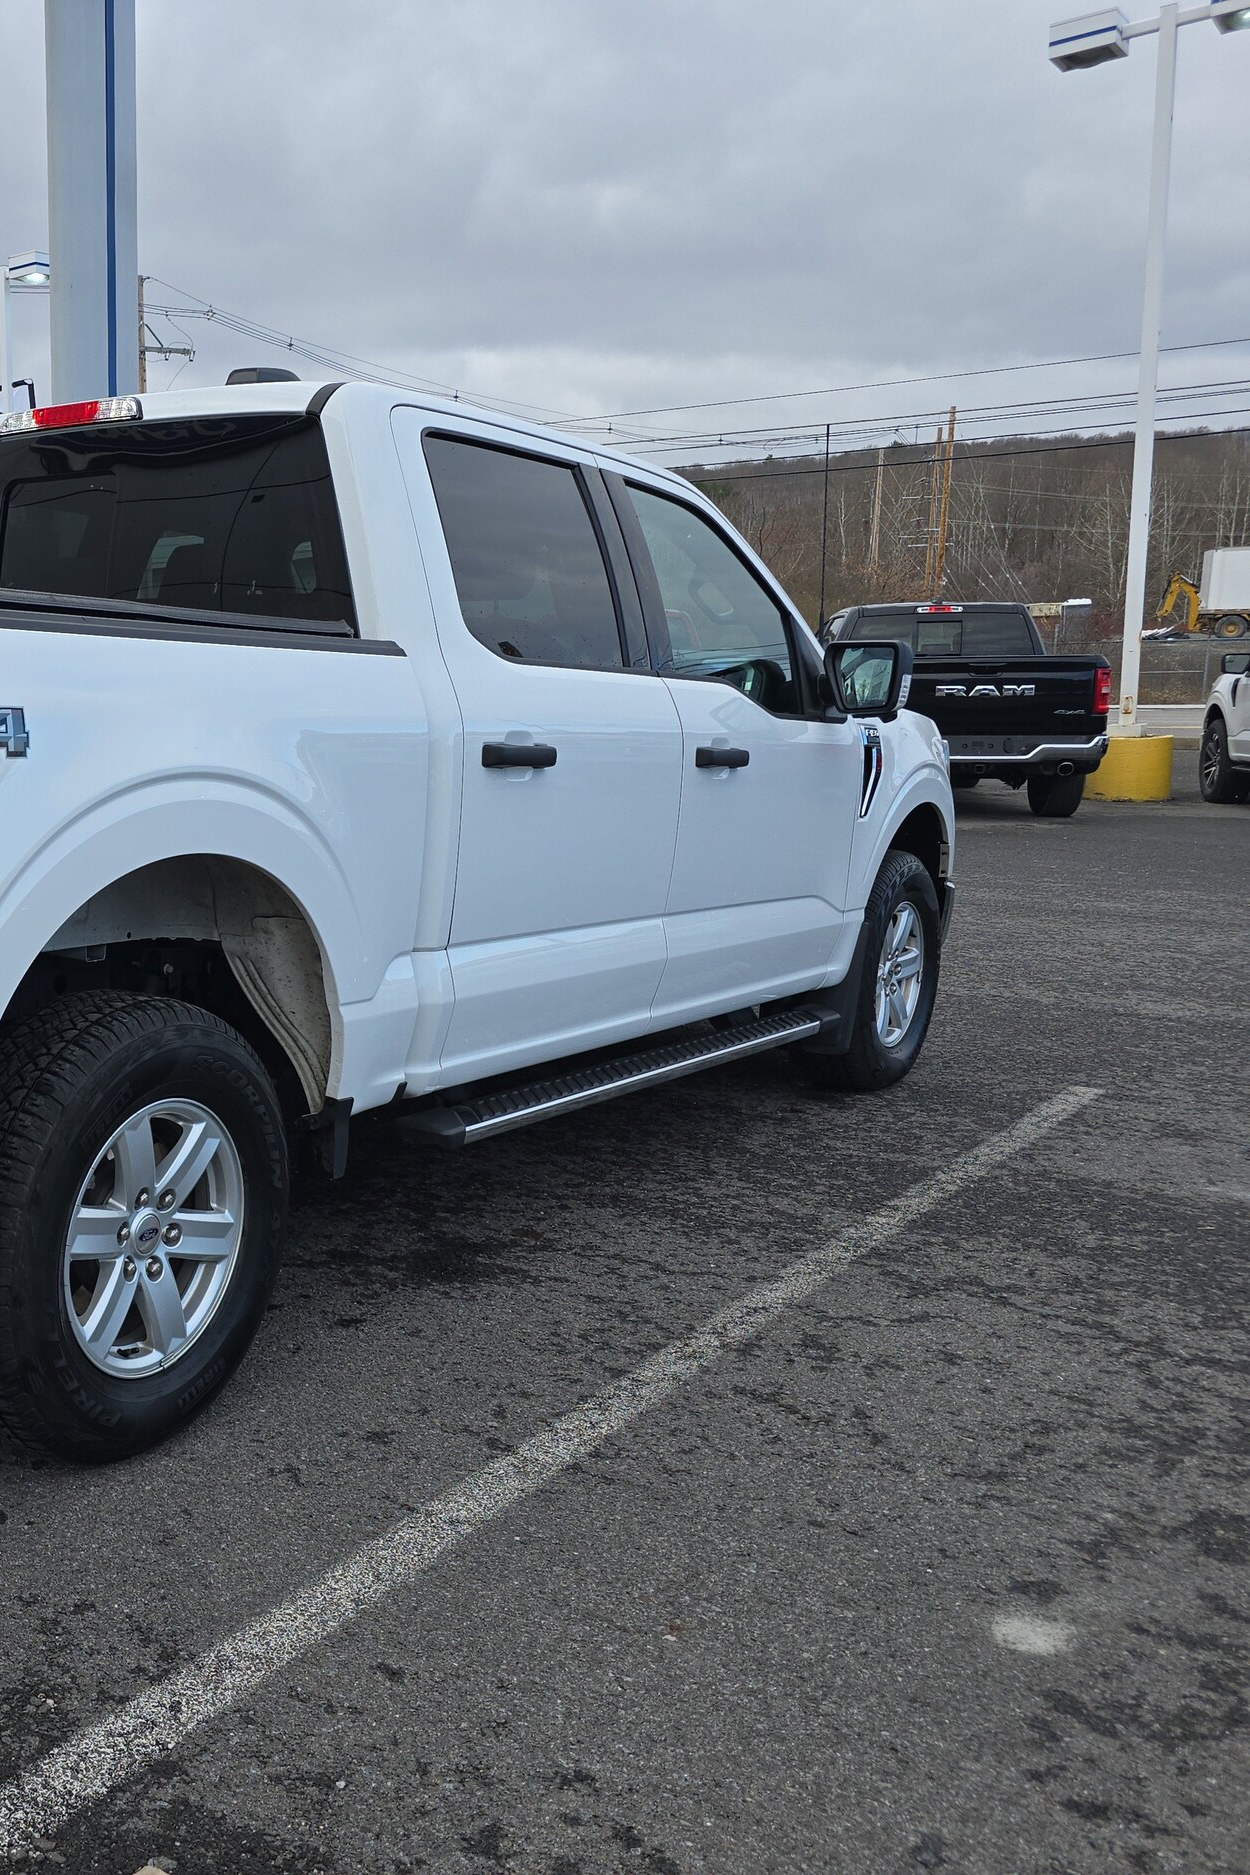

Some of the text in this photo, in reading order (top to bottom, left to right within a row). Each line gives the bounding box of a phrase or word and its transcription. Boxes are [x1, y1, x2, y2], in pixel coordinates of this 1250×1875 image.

[934, 684, 1036, 698] RAM
[193, 1055, 284, 1190] SCORPION
[141, 1229, 158, 1241] Ford
